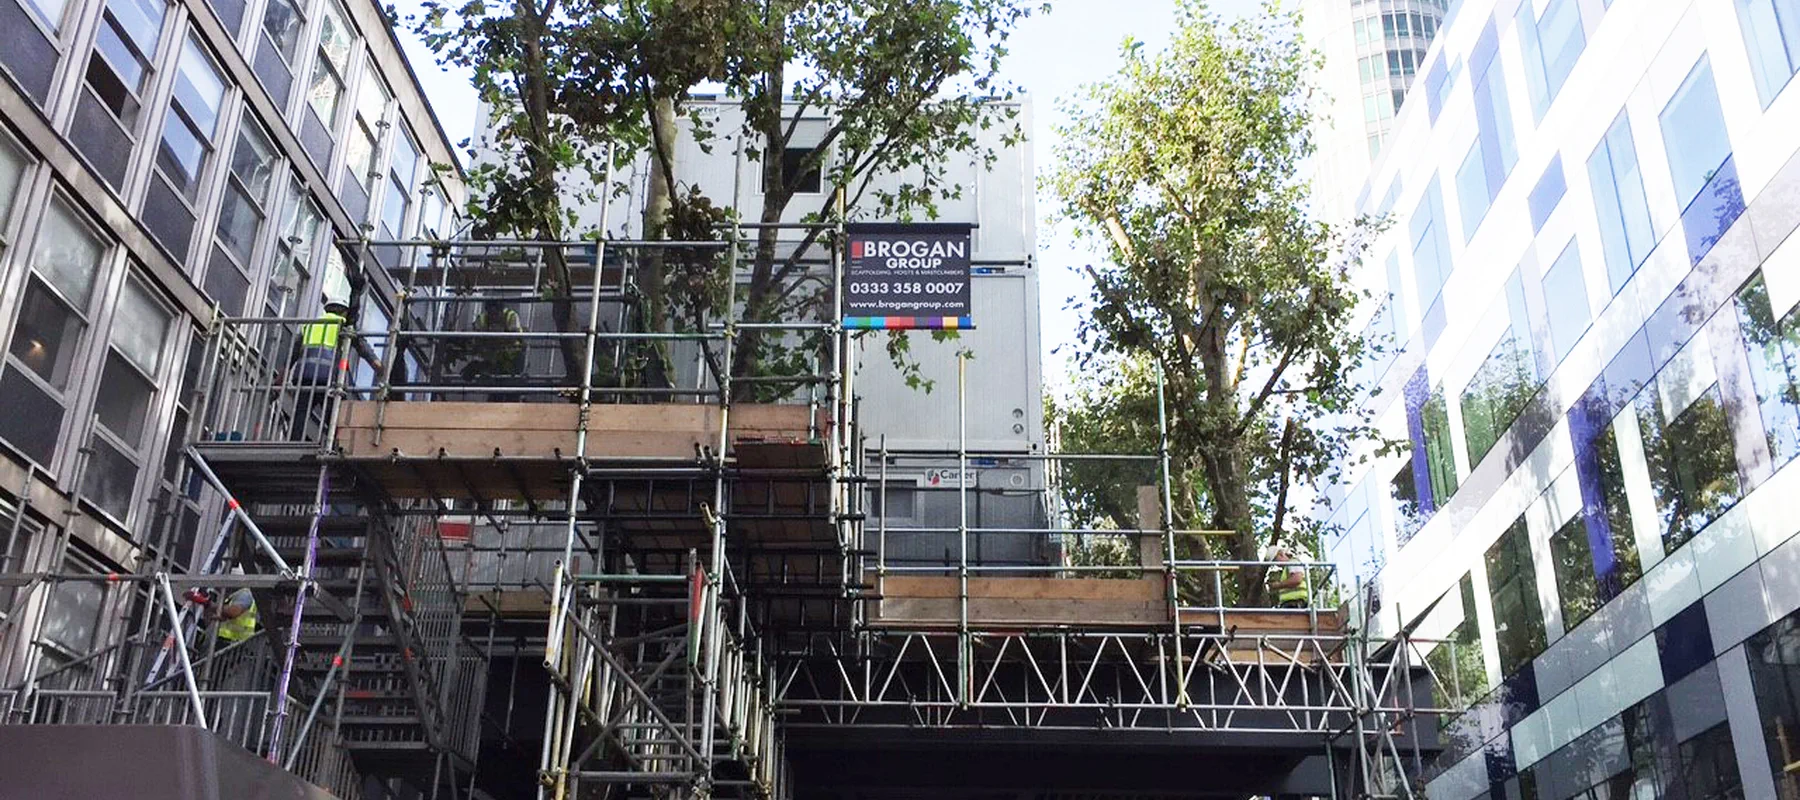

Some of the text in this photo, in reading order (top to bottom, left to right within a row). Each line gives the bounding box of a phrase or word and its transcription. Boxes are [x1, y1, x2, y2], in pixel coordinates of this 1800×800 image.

[688, 105, 717, 113] Crter
[864, 241, 964, 258] BROGAN
[886, 258, 942, 269] GROUP
[850, 282, 964, 294] 0333 358 0007
[849, 300, 964, 310] www.brogangroup.com
[940, 469, 975, 480] Carer
